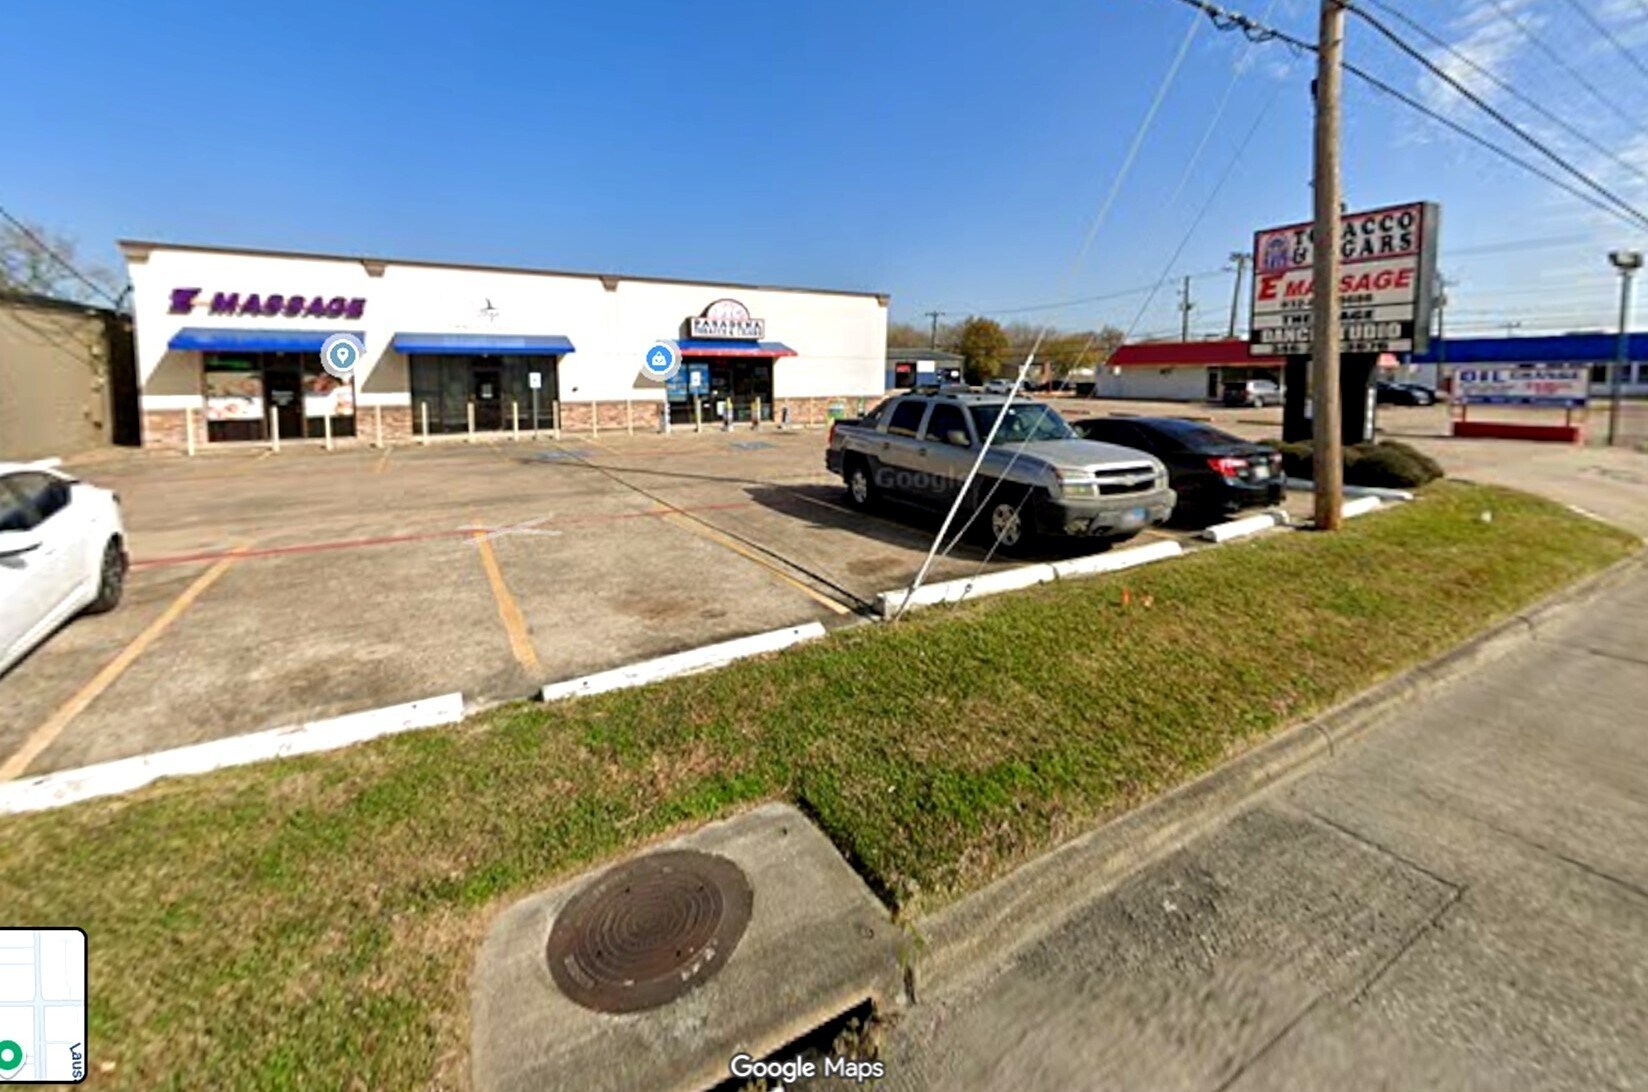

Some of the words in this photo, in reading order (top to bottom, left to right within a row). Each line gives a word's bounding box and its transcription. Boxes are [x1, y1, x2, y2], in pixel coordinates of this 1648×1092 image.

[1258, 273, 1285, 300] E
[1284, 269, 1415, 297] MASAGE
[167, 287, 202, 315] E
[208, 291, 367, 320] MASSAGE
